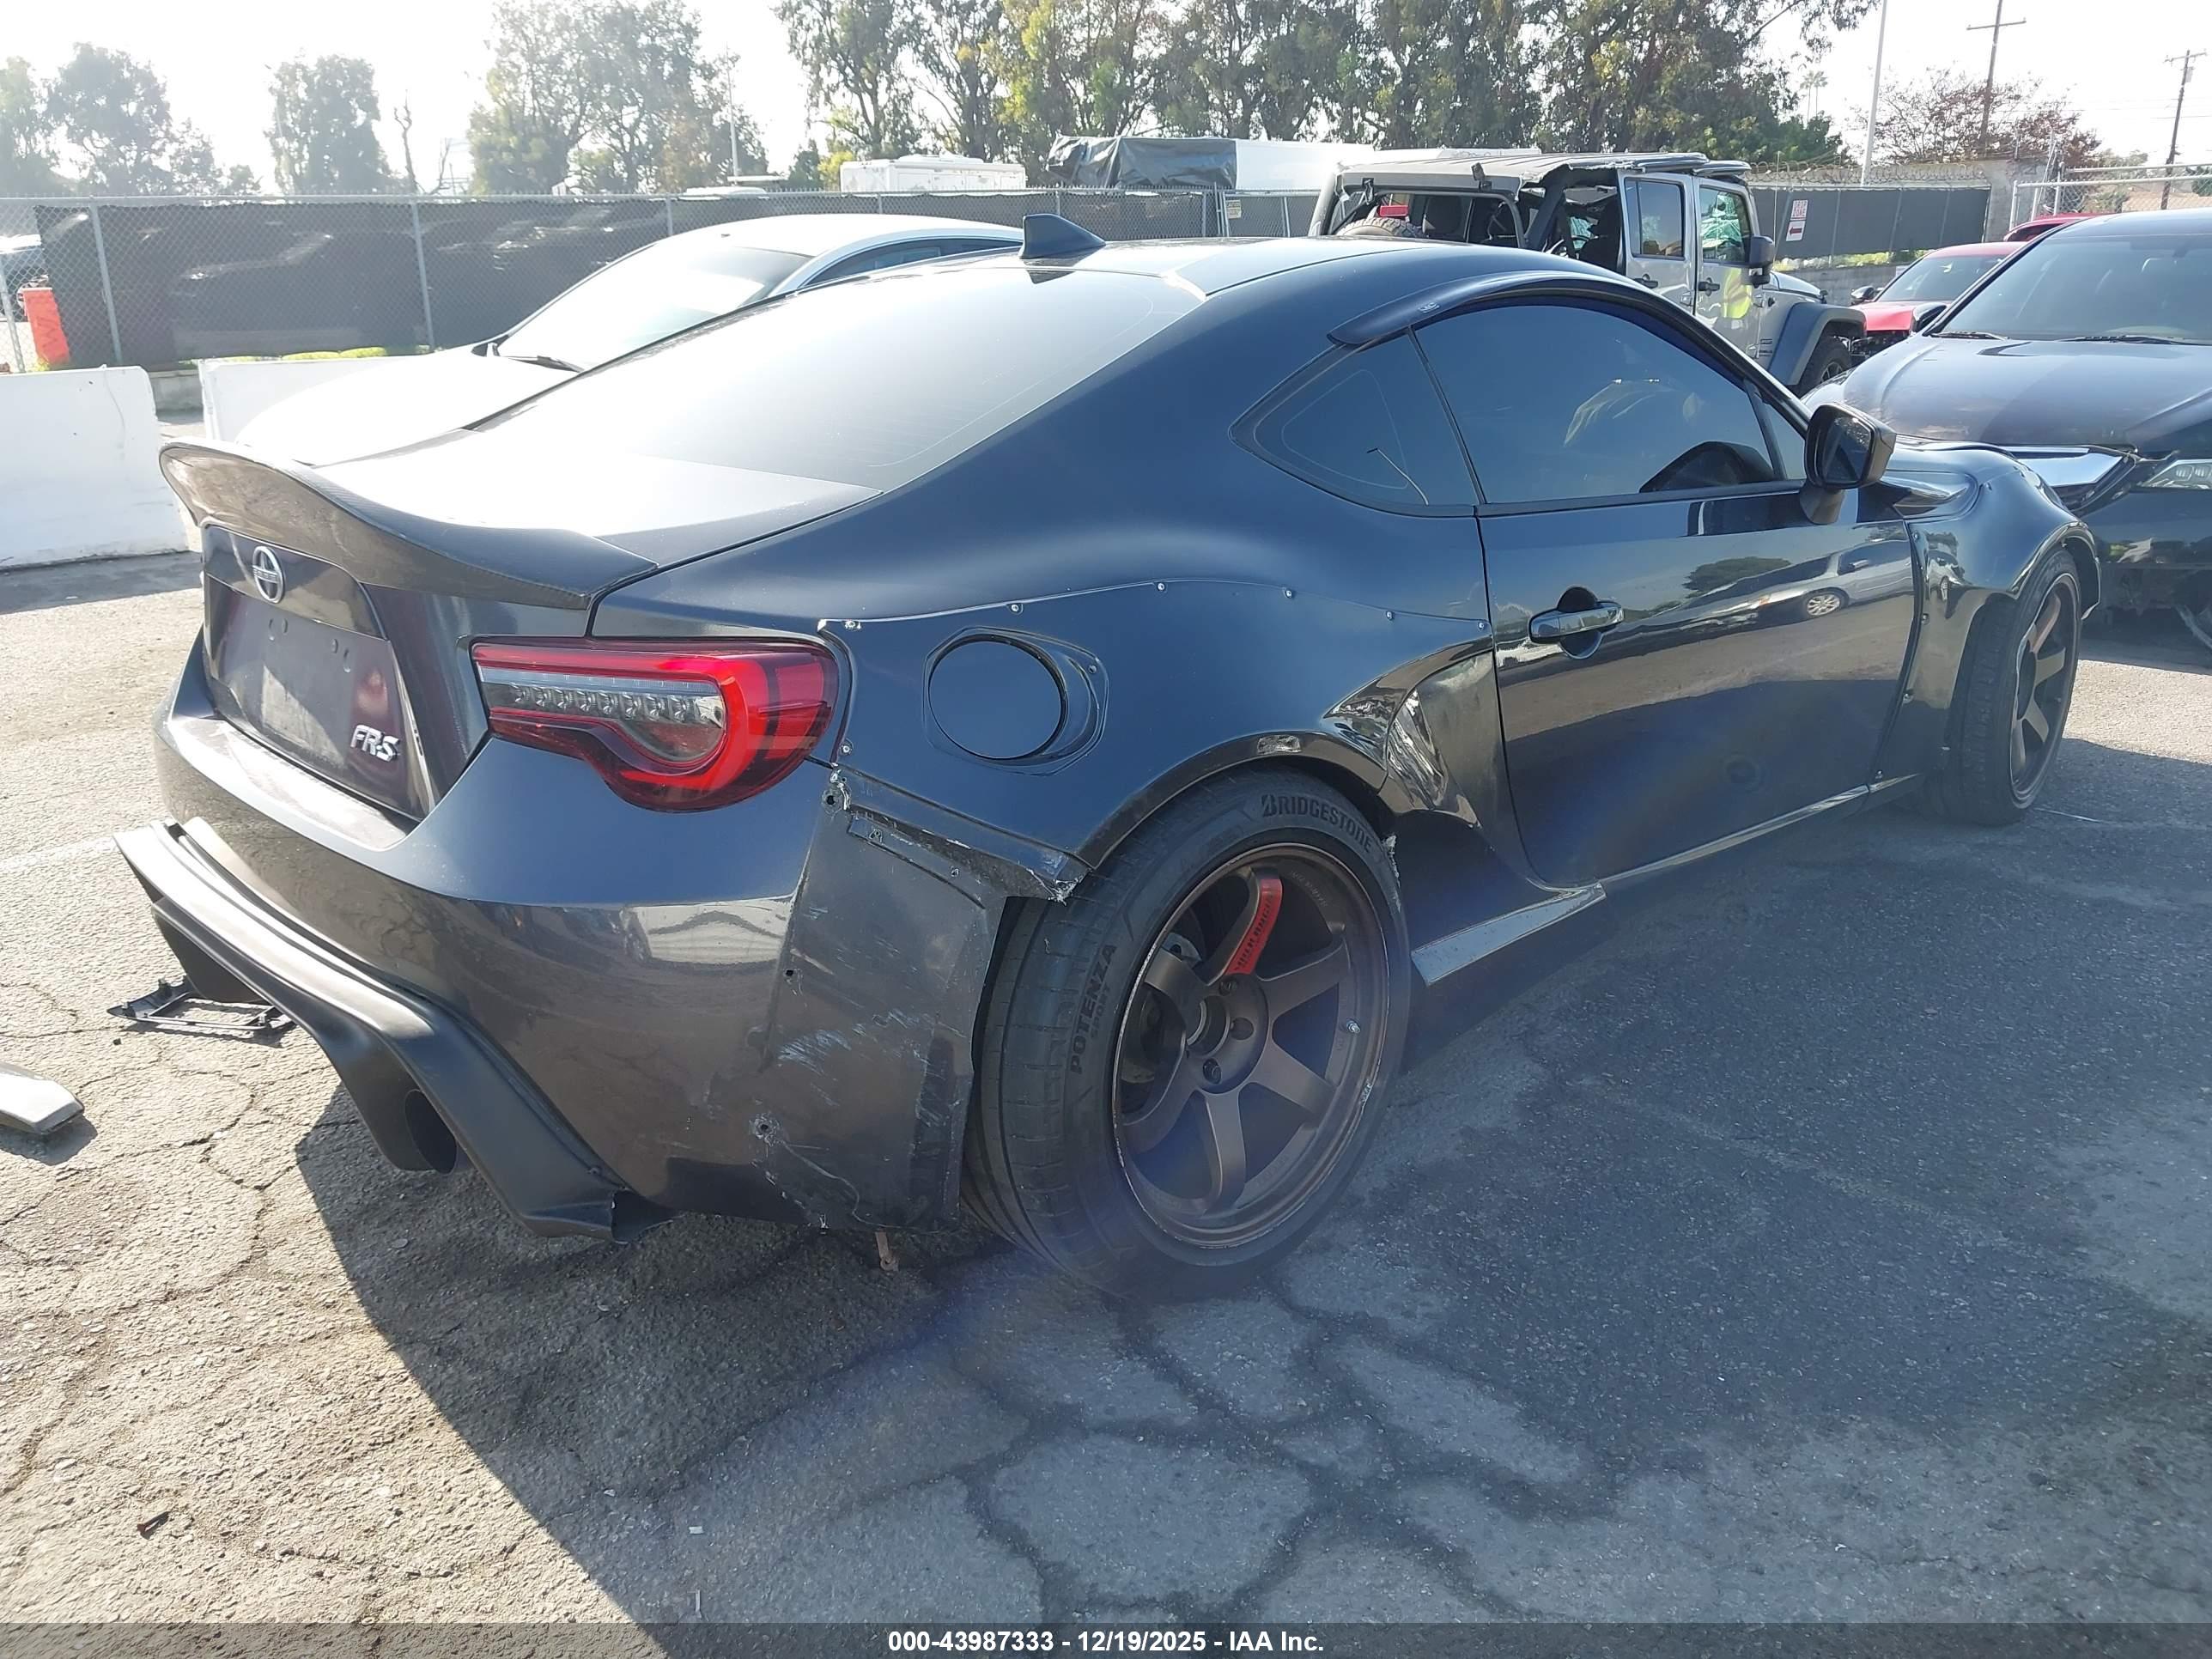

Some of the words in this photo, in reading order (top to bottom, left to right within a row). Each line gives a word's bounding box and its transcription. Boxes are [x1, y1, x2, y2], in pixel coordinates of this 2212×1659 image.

[1261, 793, 1373, 853] BRIDGESTONE
[1071, 945, 1117, 1074] POTENZA
[1091, 982, 1110, 1040] SPORT
